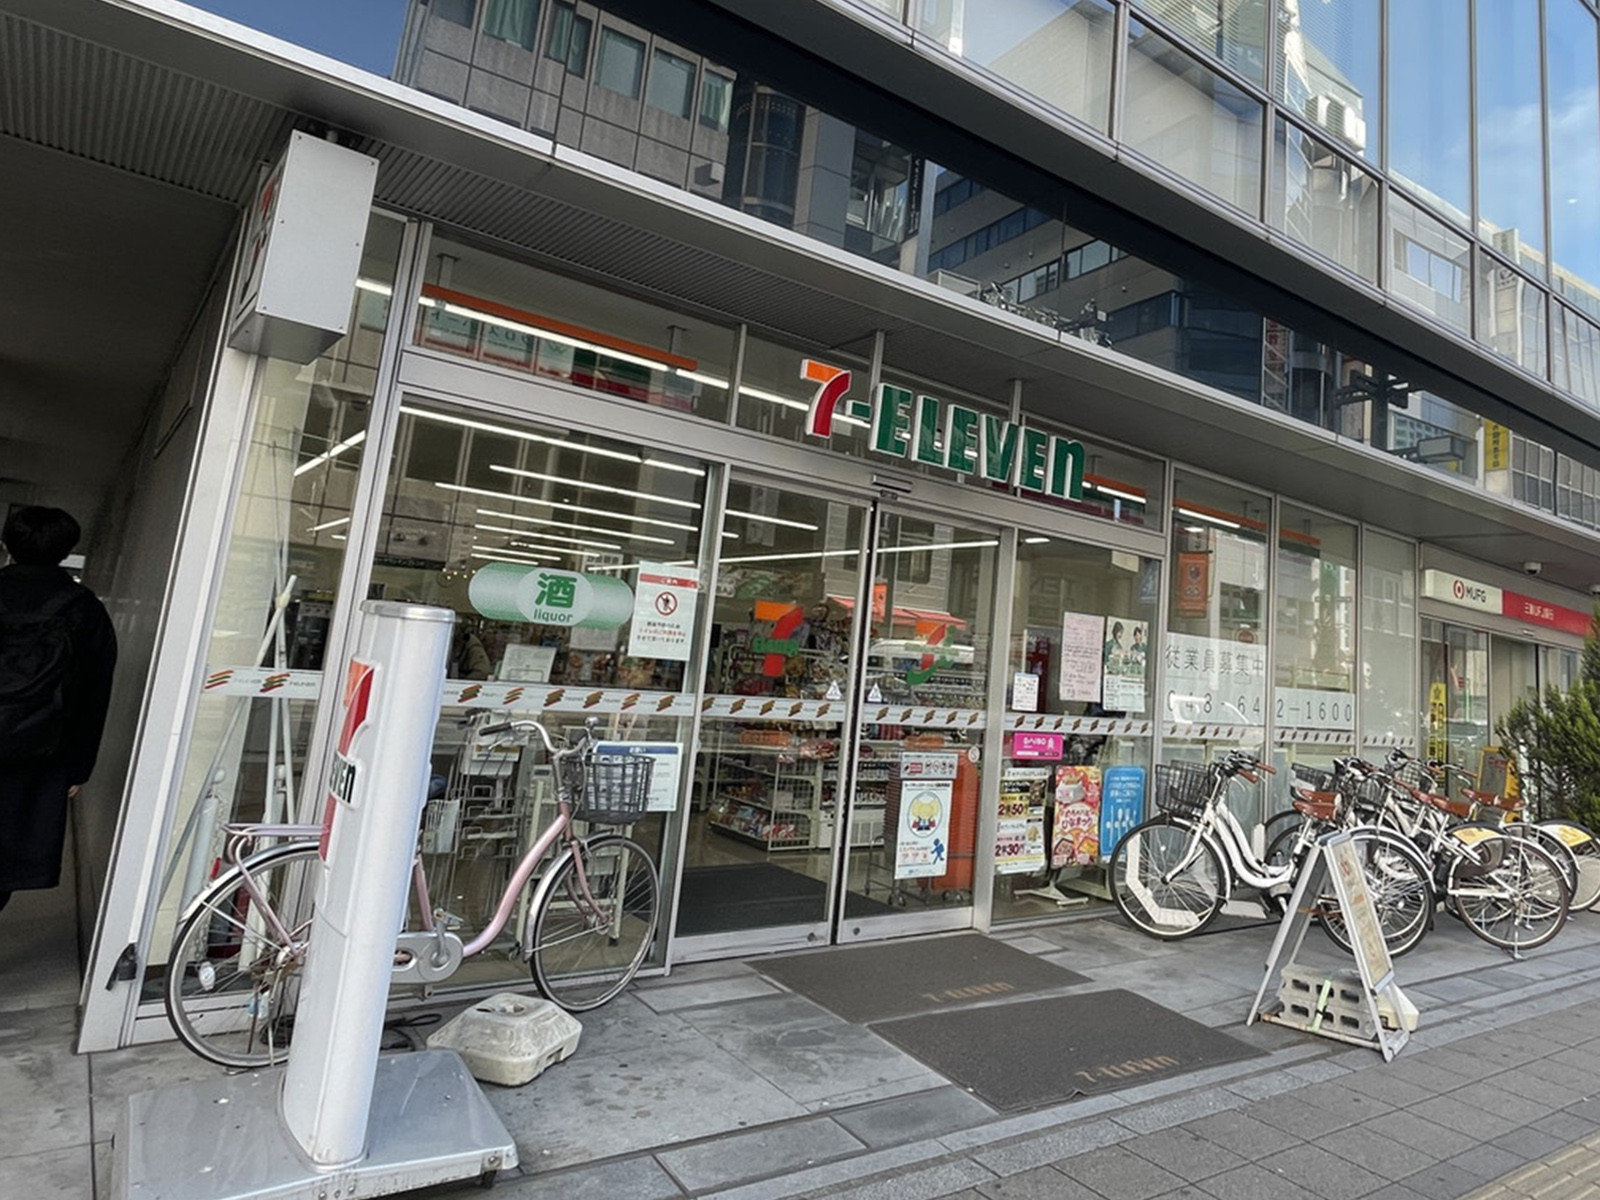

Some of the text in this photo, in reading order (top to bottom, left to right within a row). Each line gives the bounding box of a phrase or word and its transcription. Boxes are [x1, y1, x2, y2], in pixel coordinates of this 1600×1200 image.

[535, 572, 577, 609] 酒
[1466, 585, 1487, 604] MUFG
[533, 608, 573, 623] liquor
[1164, 643, 1264, 678] 従業員募集中
